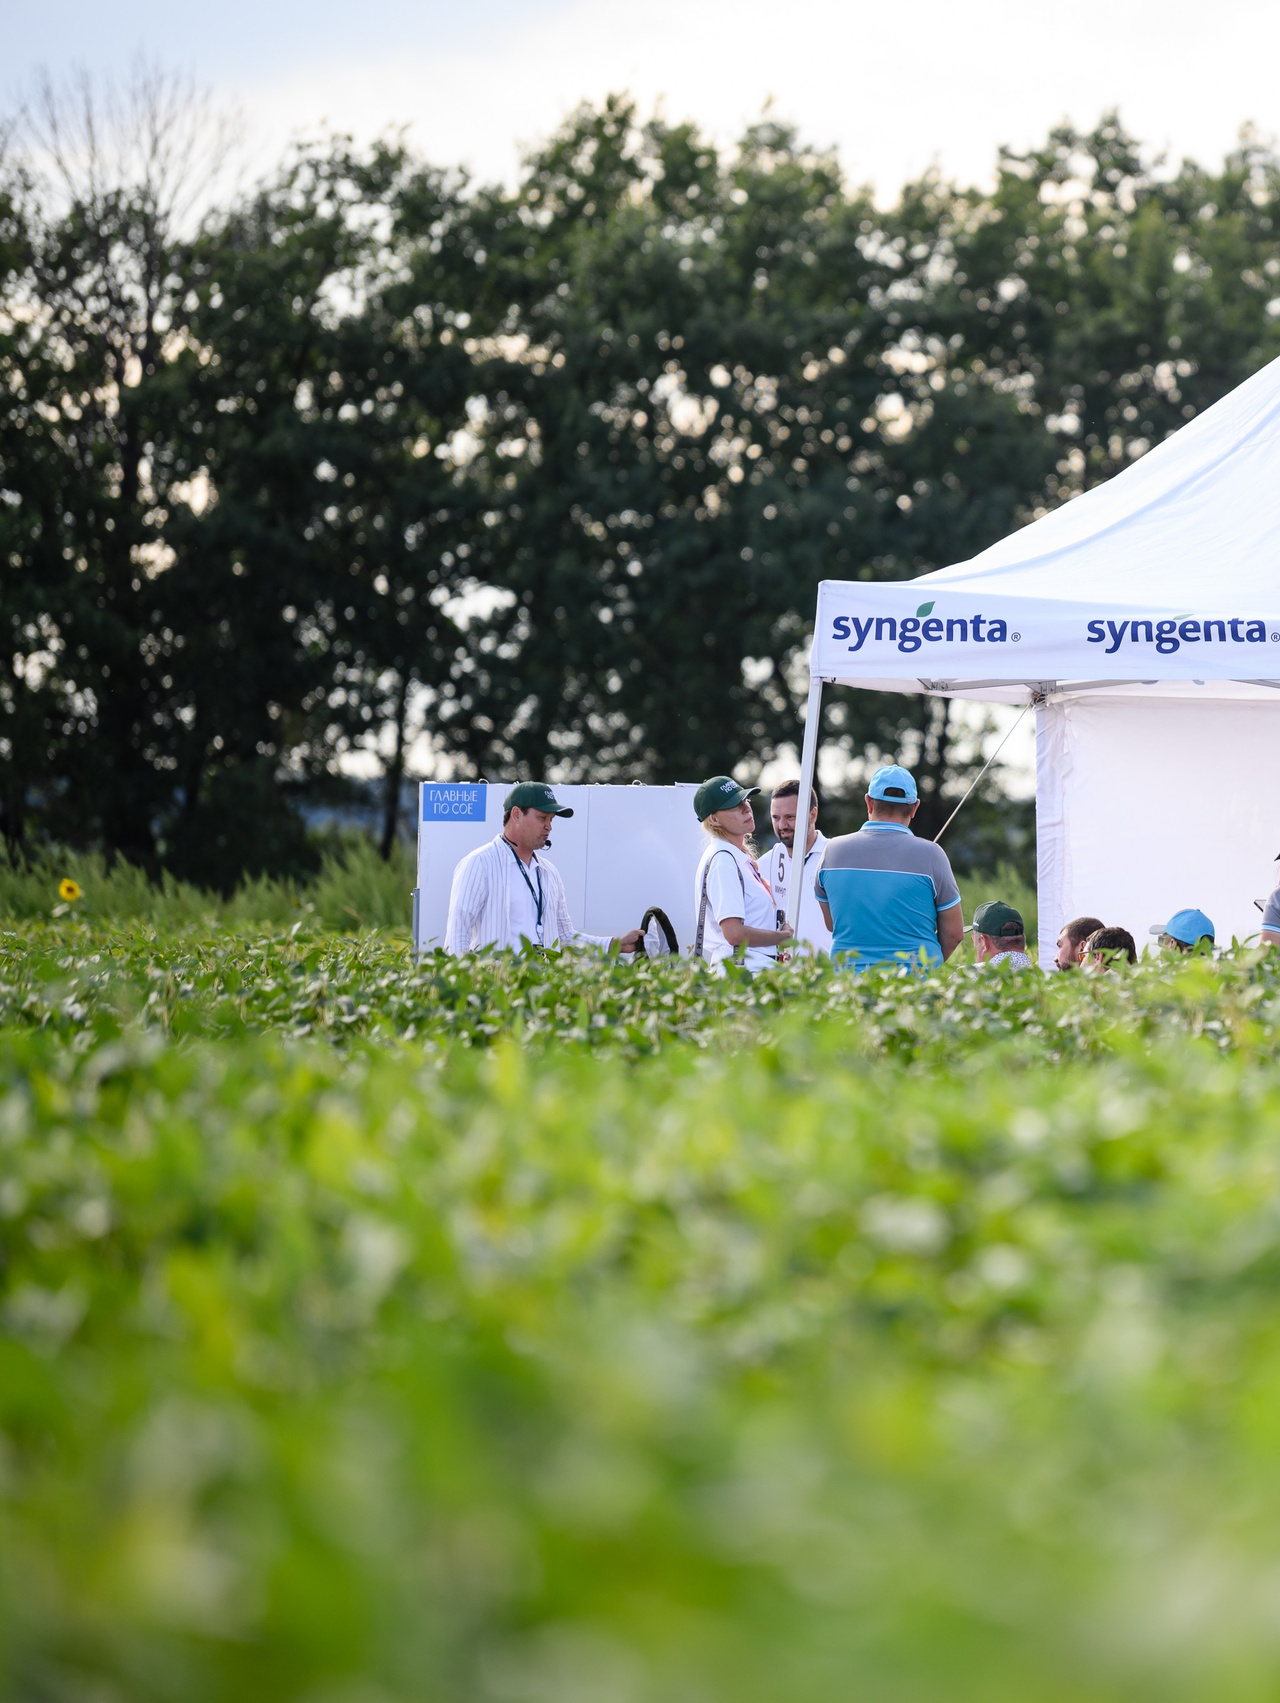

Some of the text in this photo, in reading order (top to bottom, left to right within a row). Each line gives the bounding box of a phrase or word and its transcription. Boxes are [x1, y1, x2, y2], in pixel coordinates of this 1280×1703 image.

[832, 615, 1007, 652] syngenta
[1087, 619, 1266, 654] syngenta
[429, 790, 478, 802] ГЛАВНЫЕ
[433, 803, 473, 815] ПО СОЕ
[778, 852, 785, 883] 5
